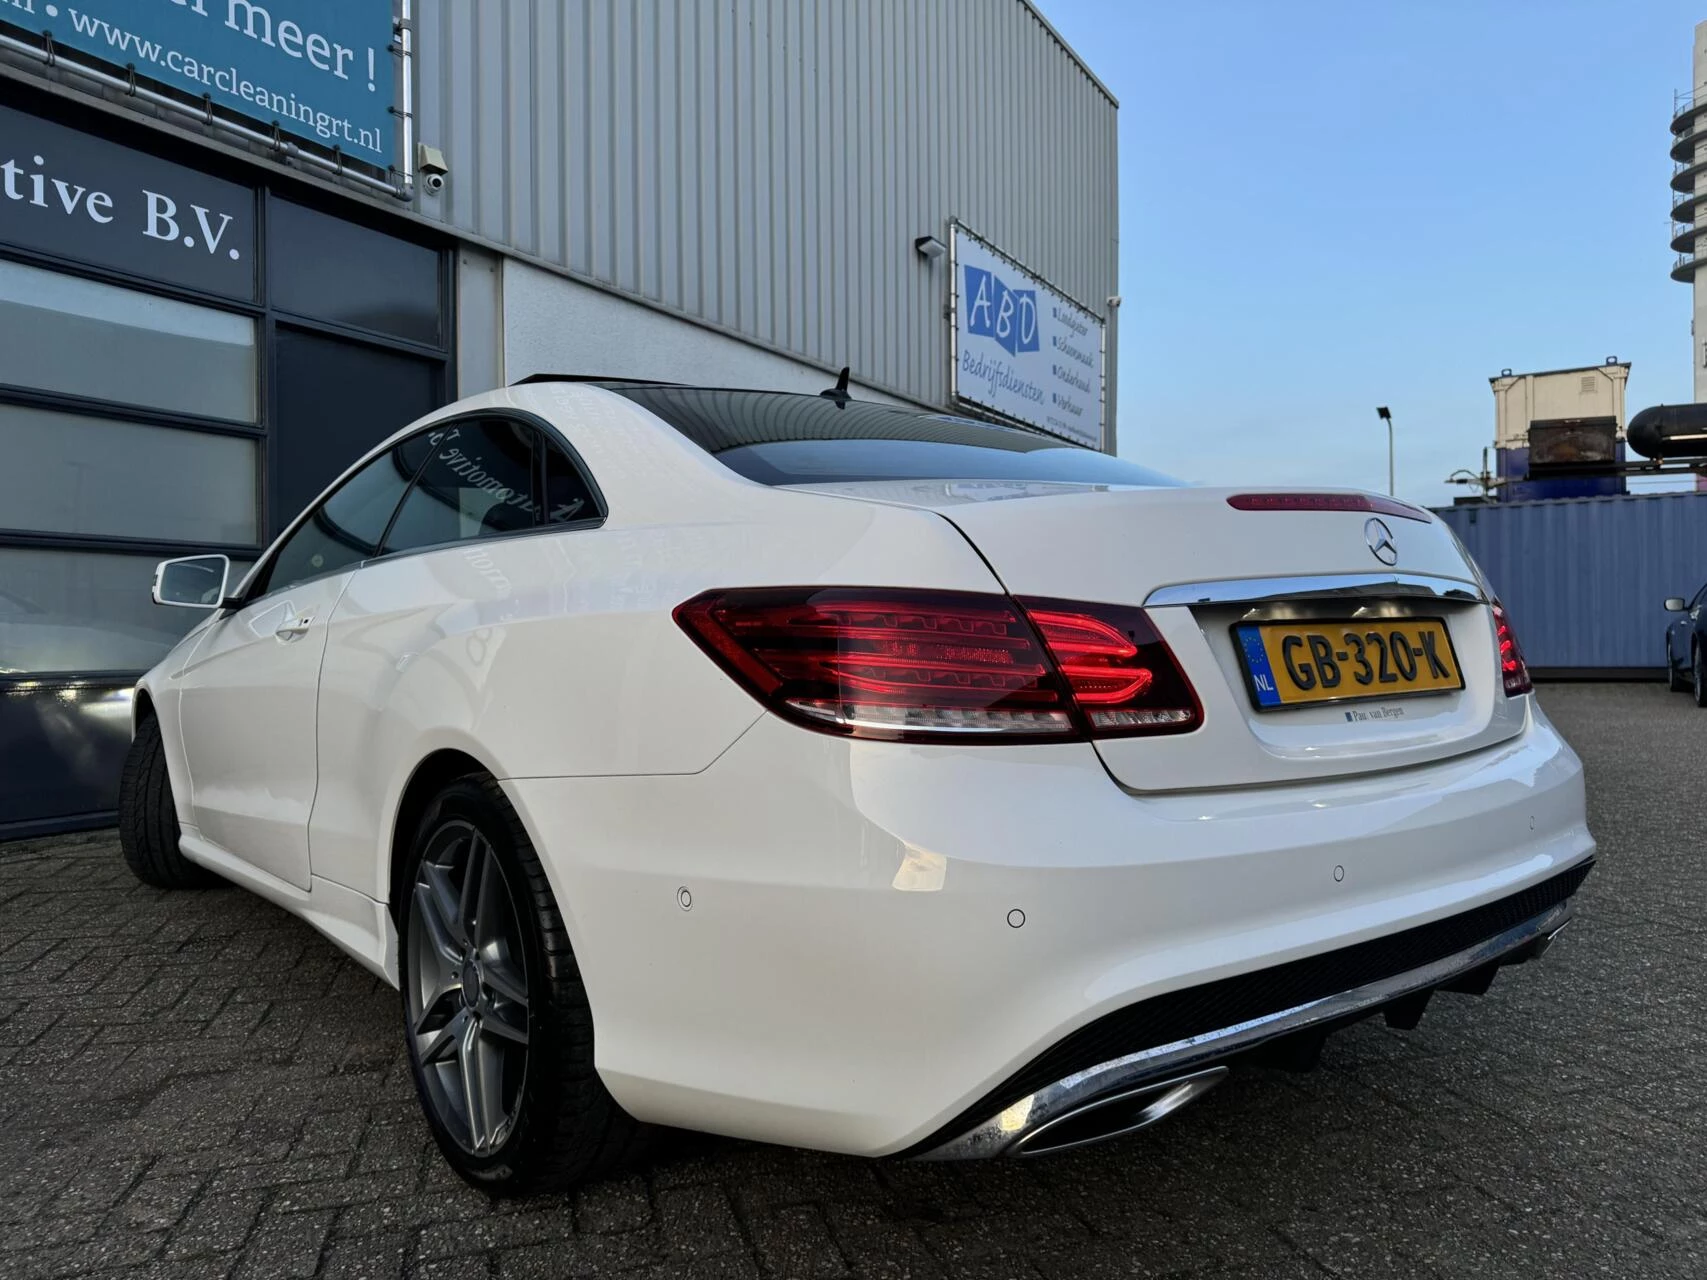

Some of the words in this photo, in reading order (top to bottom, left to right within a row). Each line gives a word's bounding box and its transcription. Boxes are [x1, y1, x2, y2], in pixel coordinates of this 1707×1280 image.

[67, 8, 383, 154] www.carcleaningrt.nl
[223, 0, 354, 80] meer
[366, 47, 377, 92] !
[0, 155, 114, 224] tive
[142, 189, 241, 261] B.V.
[969, 274, 1036, 345] ABD
[962, 349, 1046, 405] Bedrijfsdiensten
[1253, 674, 1274, 692] NL
[1281, 630, 1450, 691] GB-320-K
[1368, 710, 1383, 719] van
